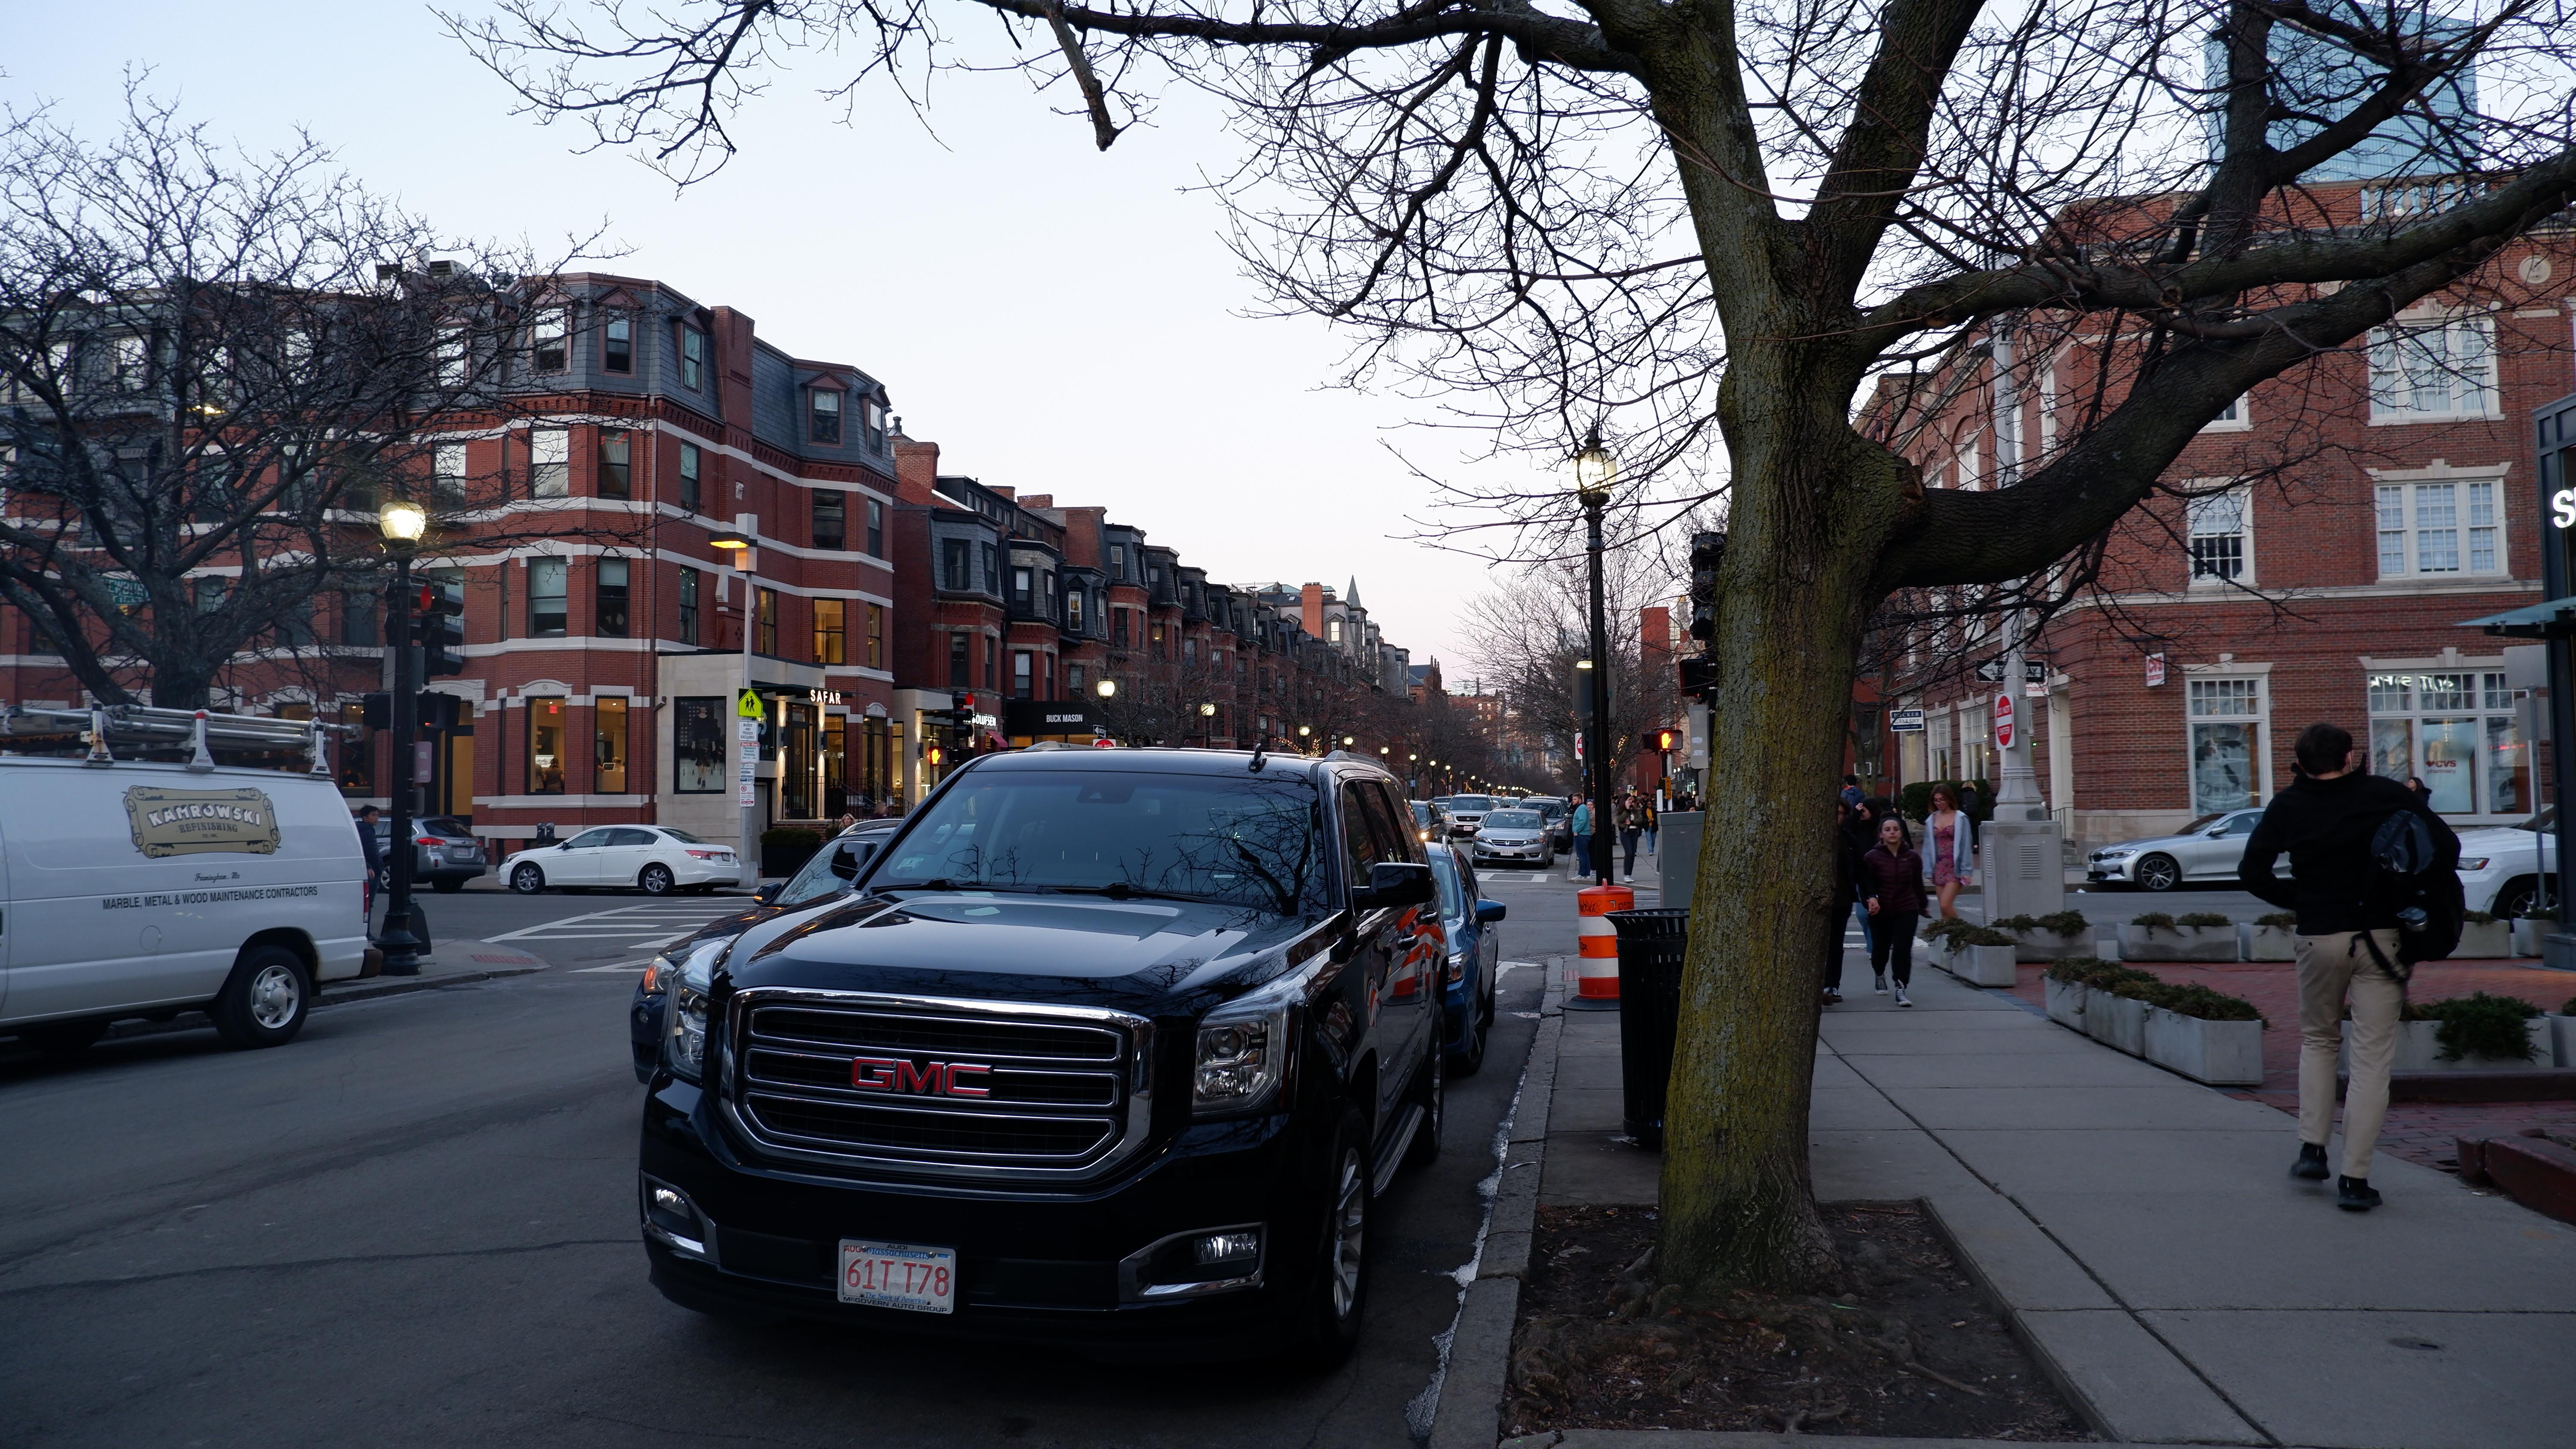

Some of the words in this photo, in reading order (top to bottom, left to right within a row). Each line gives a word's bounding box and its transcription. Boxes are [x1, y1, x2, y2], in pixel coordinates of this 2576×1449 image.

[810, 689, 841, 705] SAFAR
[976, 714, 996, 727] OLUFSEN
[1046, 714, 1062, 722] BUCK
[1999, 726, 2011, 736] ENTER
[148, 803, 260, 828] KAMROWSKI
[178, 822, 238, 834] REFINISHING
[103, 897, 143, 909] MARBLE,
[145, 895, 173, 907] METAL
[175, 894, 180, 905] &
[182, 892, 208, 904] WOOD
[210, 889, 264, 902] MAINTENANCE
[266, 886, 318, 899] CONTRACTORS
[851, 1056, 993, 1098] GMC
[847, 1258, 895, 1291] 61T
[903, 1261, 949, 1297] T78
[878, 1293, 893, 1301] Spirit
